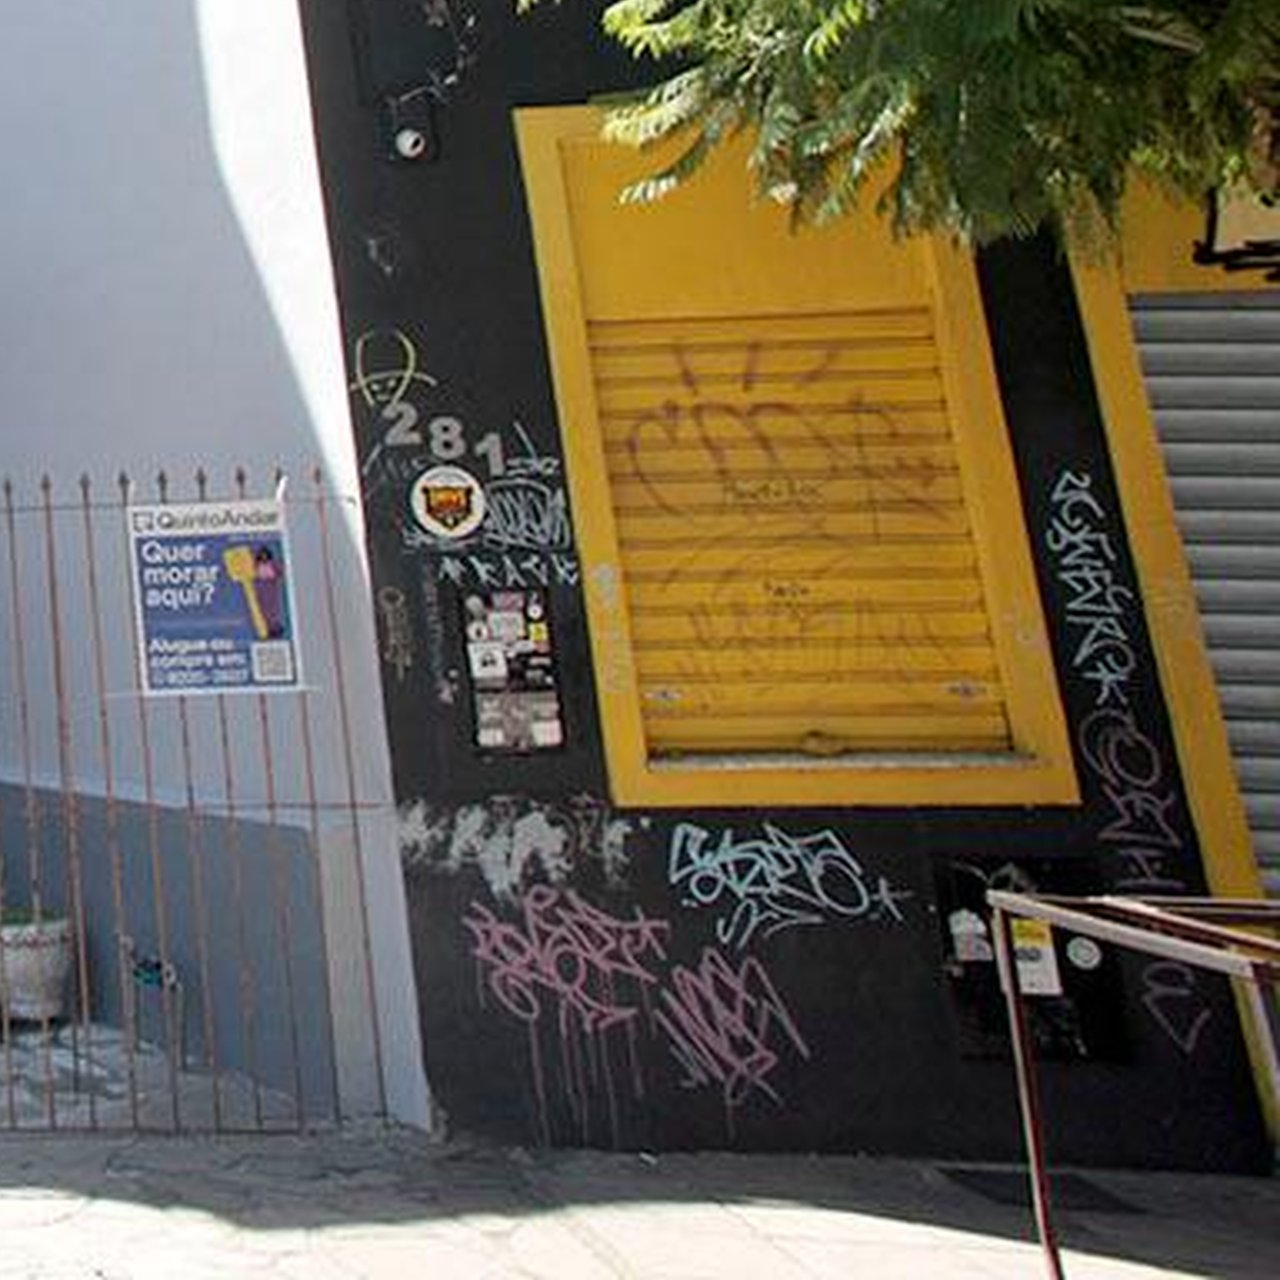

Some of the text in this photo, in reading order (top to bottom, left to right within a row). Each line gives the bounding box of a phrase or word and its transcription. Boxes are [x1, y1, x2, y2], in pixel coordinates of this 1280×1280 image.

[382, 402, 508, 476] 281
[141, 540, 205, 563] Quer
[143, 565, 219, 584] morar
[146, 584, 215, 609] aqui?
